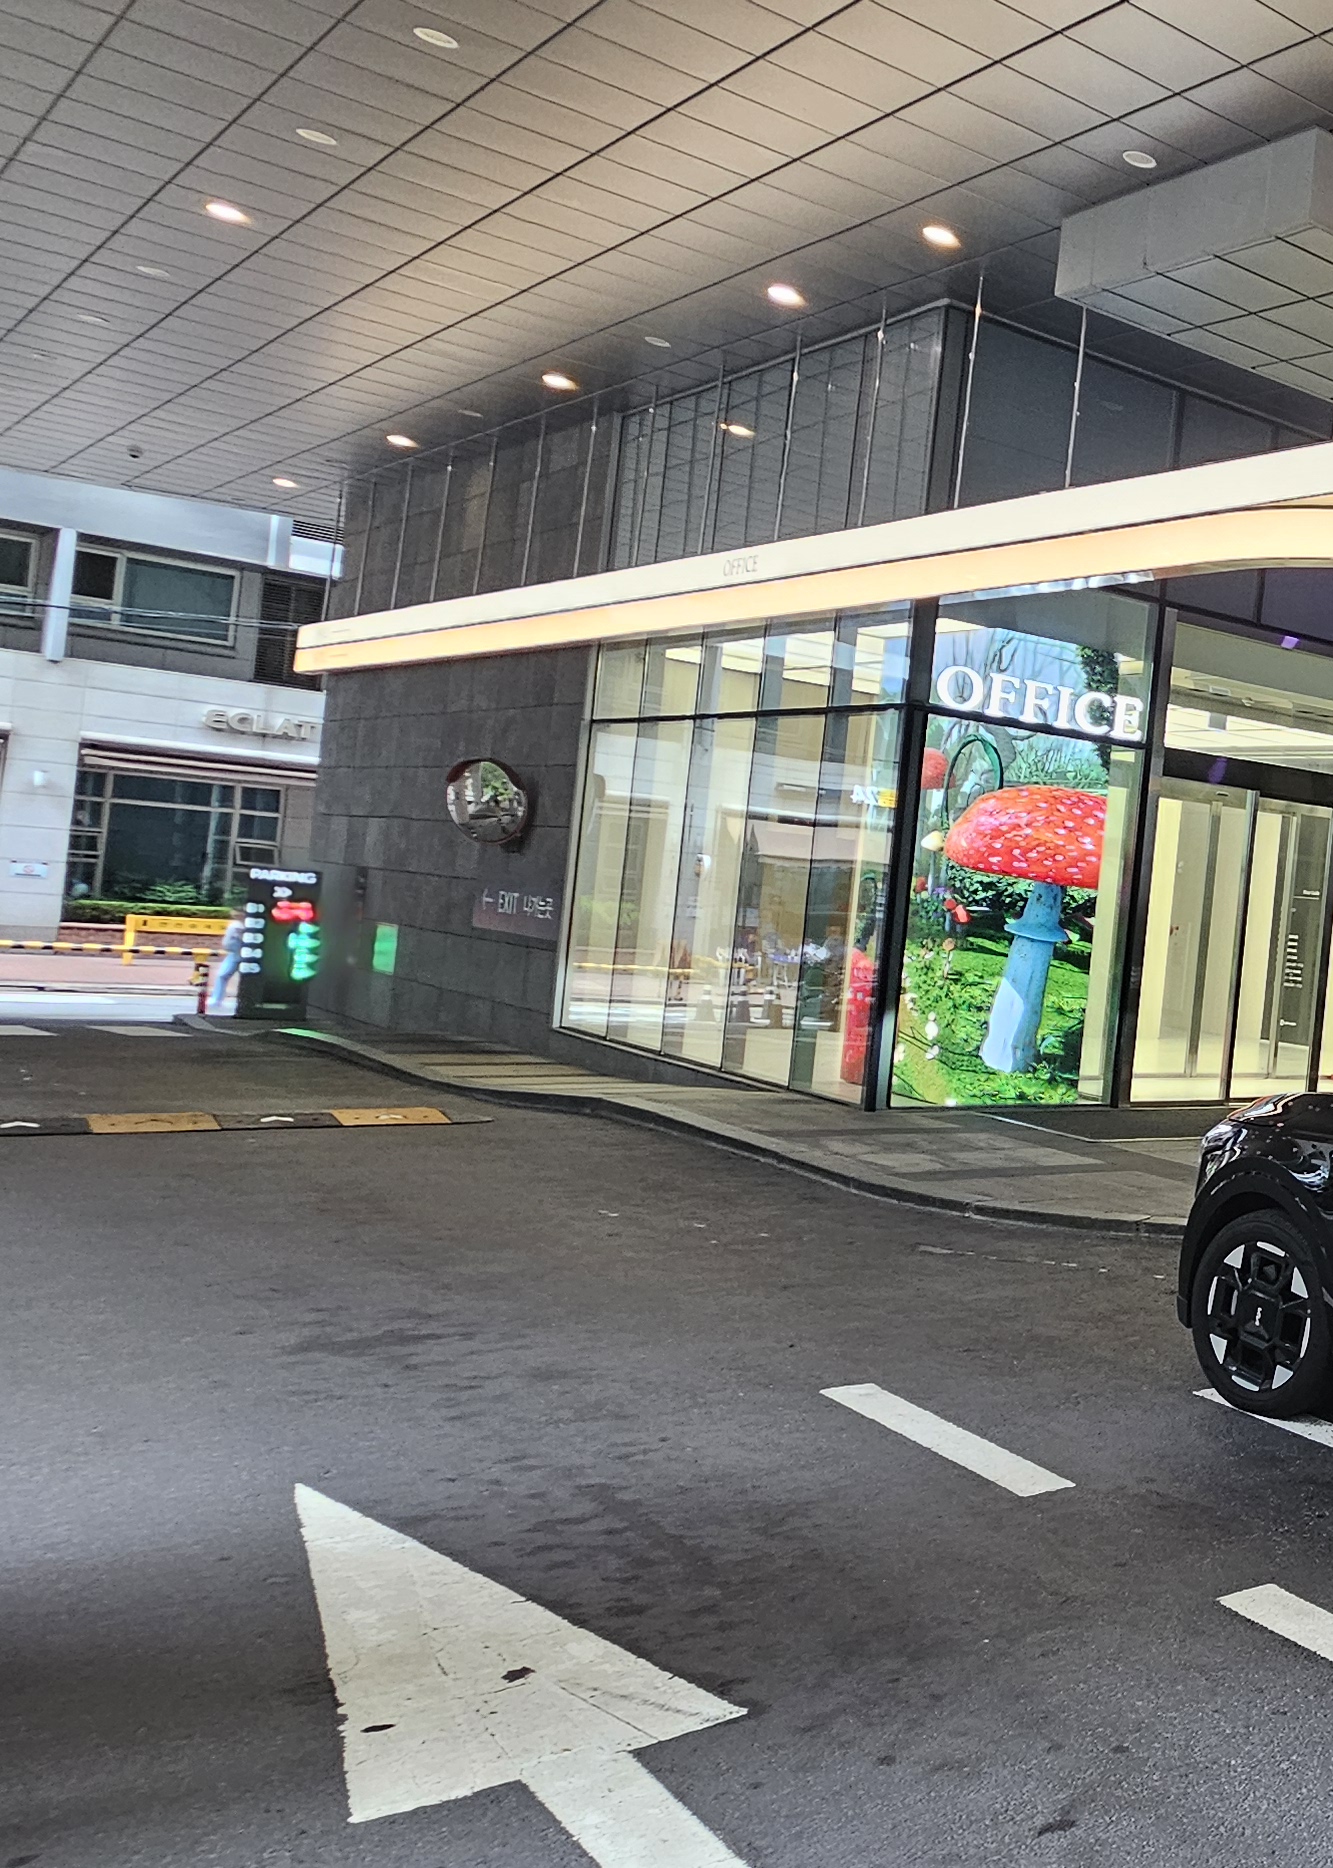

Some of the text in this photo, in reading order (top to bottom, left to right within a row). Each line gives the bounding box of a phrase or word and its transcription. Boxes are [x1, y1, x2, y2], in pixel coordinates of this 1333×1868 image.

[723, 554, 759, 577] OFFICE
[936, 665, 1144, 741] OFFICE
[250, 868, 318, 884] PARKING
[498, 890, 520, 914] EXIT
